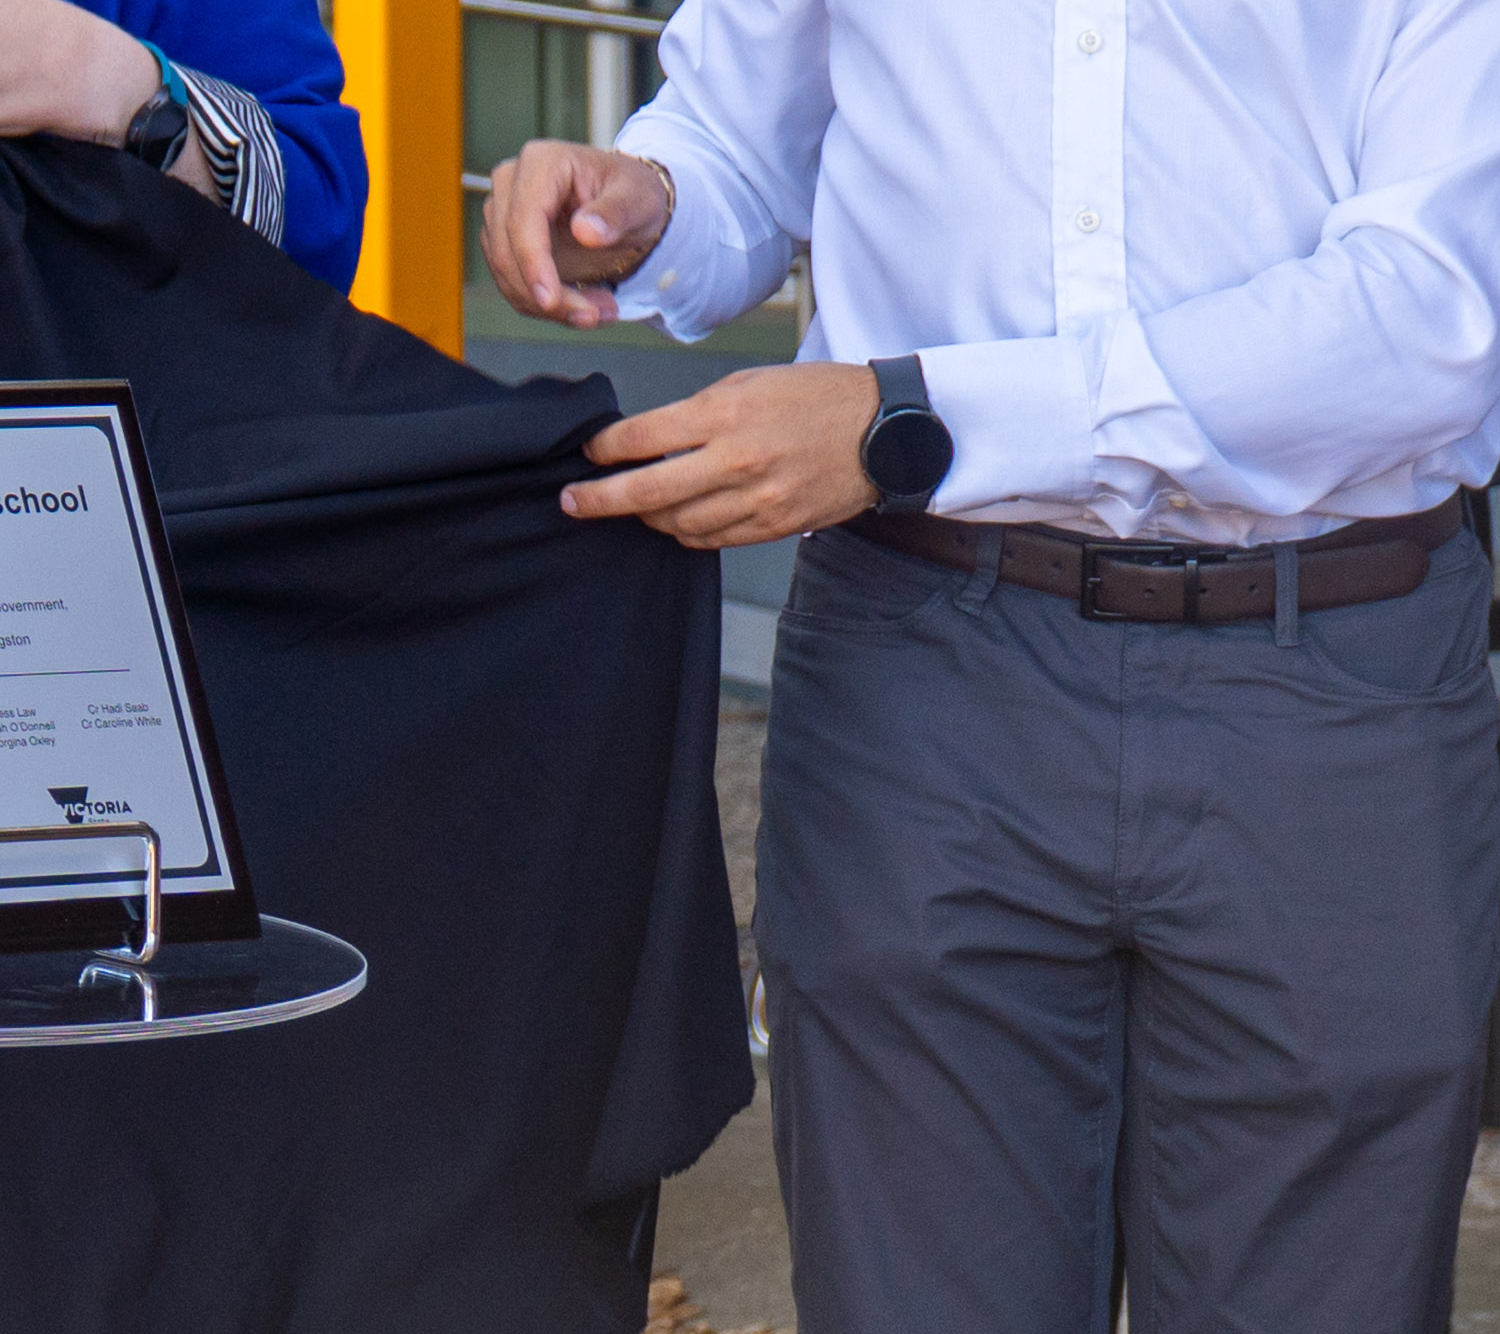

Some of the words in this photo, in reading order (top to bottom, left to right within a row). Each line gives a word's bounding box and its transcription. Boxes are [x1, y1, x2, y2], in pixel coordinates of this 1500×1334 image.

[16, 707, 37, 718] Law
[87, 704, 99, 715] Cr
[81, 719, 93, 729] Cr
[94, 718, 134, 729] Caroline
[134, 716, 162, 727] White
[29, 736, 56, 748] Oxley
[58, 800, 133, 817] VICTORIA
